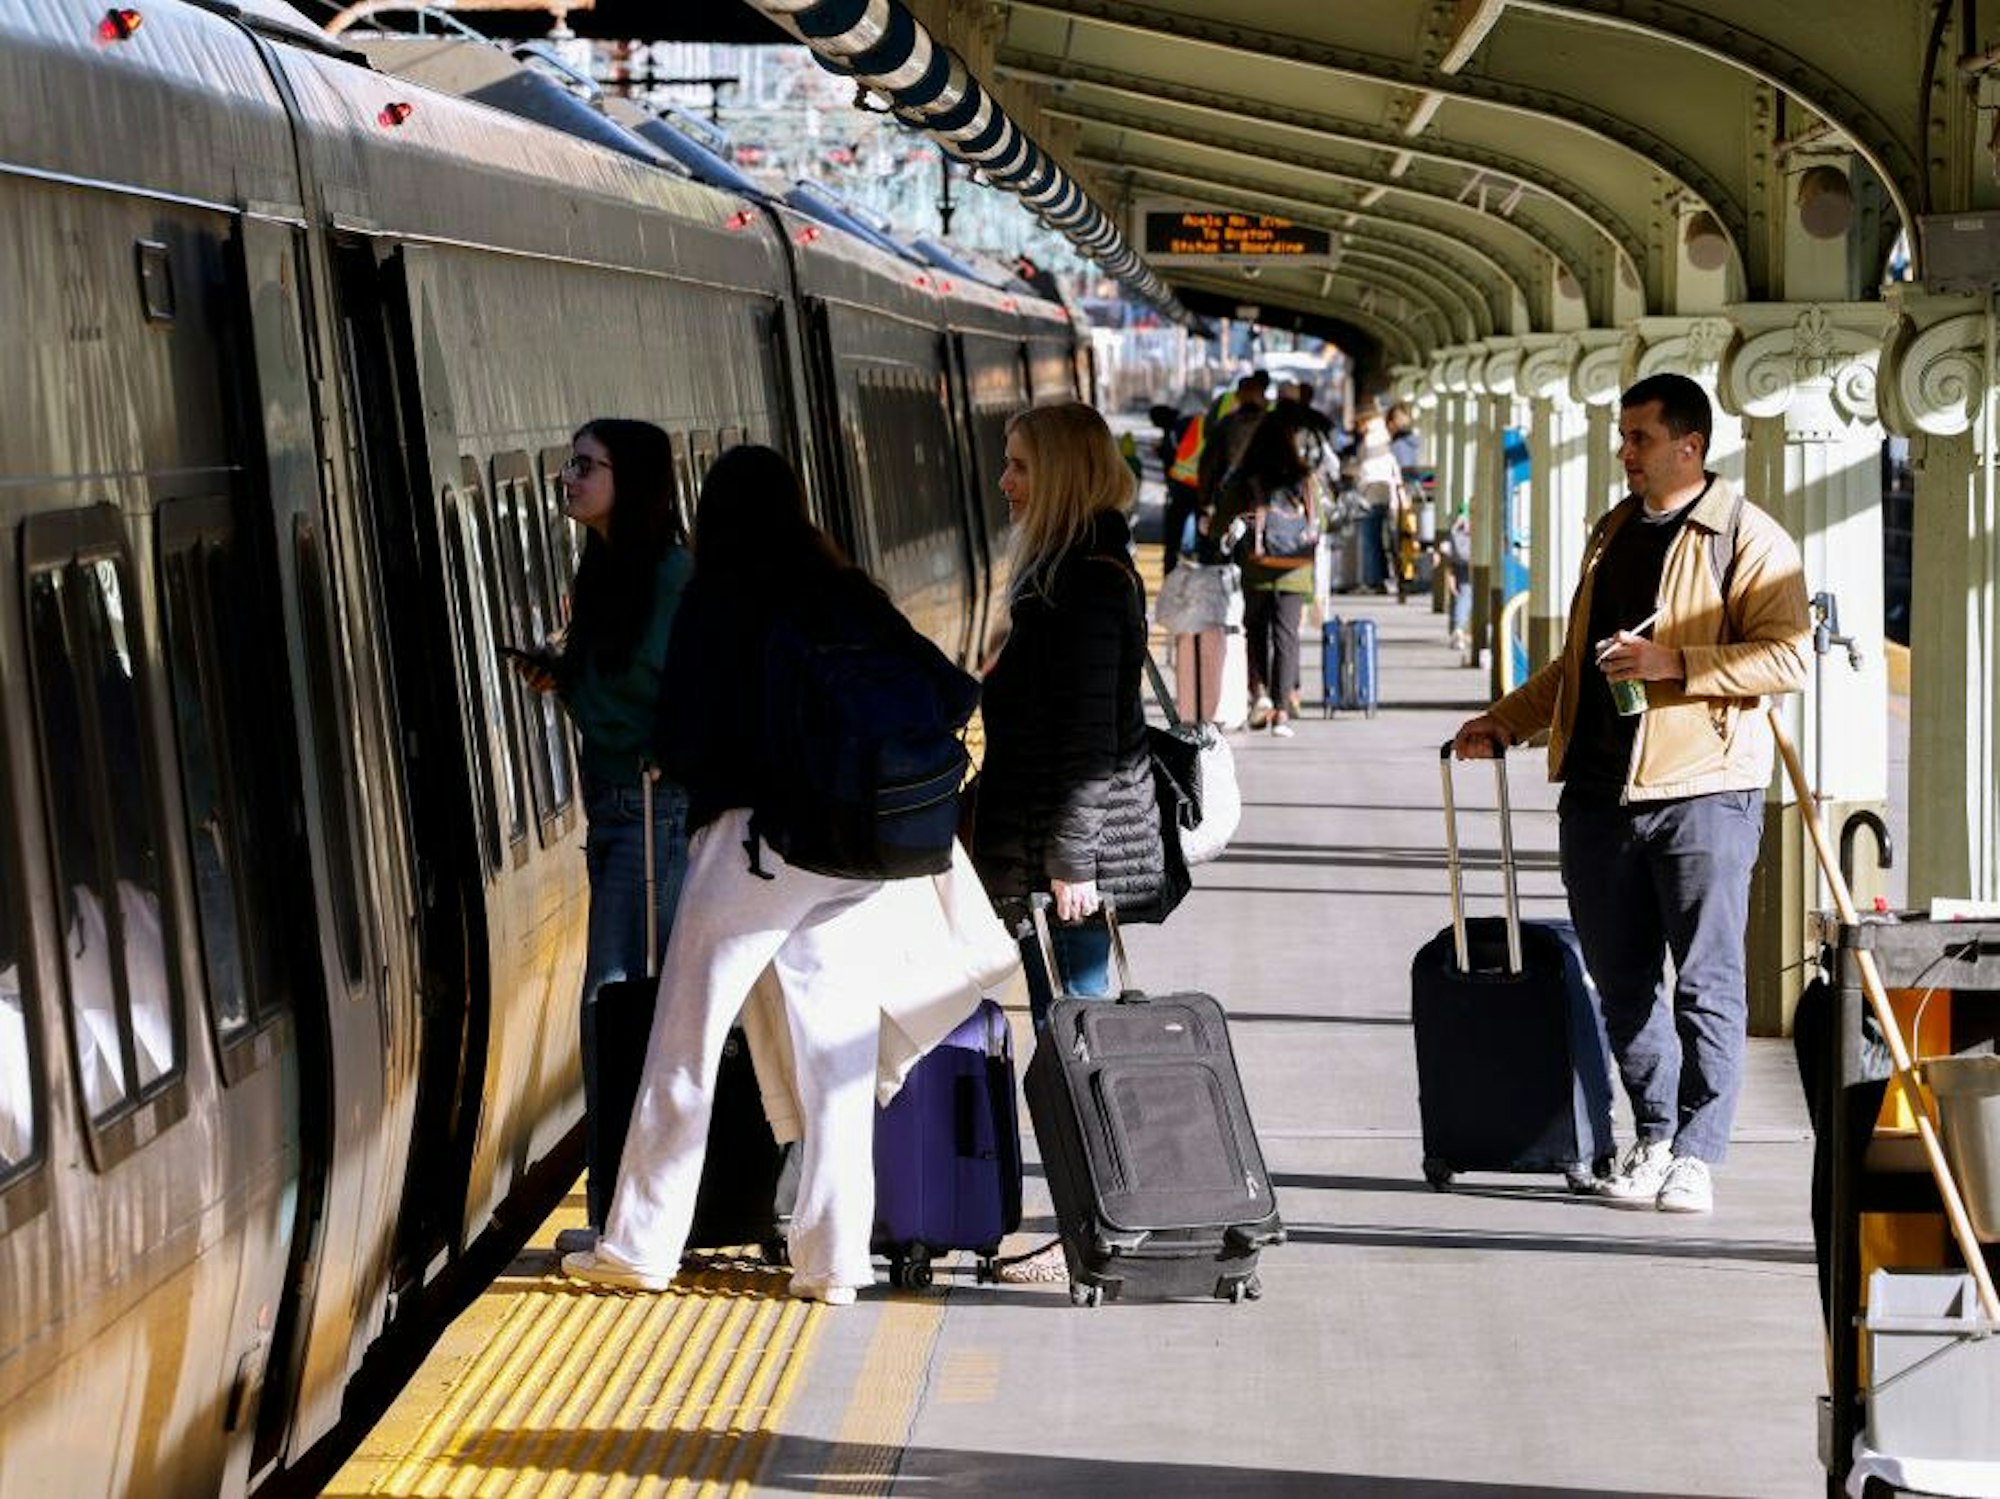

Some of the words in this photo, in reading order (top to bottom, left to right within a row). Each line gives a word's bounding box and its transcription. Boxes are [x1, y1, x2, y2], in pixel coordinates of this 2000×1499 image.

[1203, 227, 1219, 240] To
[1224, 227, 1274, 240] Boston
[1170, 239, 1220, 253] Status
[1239, 239, 1304, 254] Boarding
